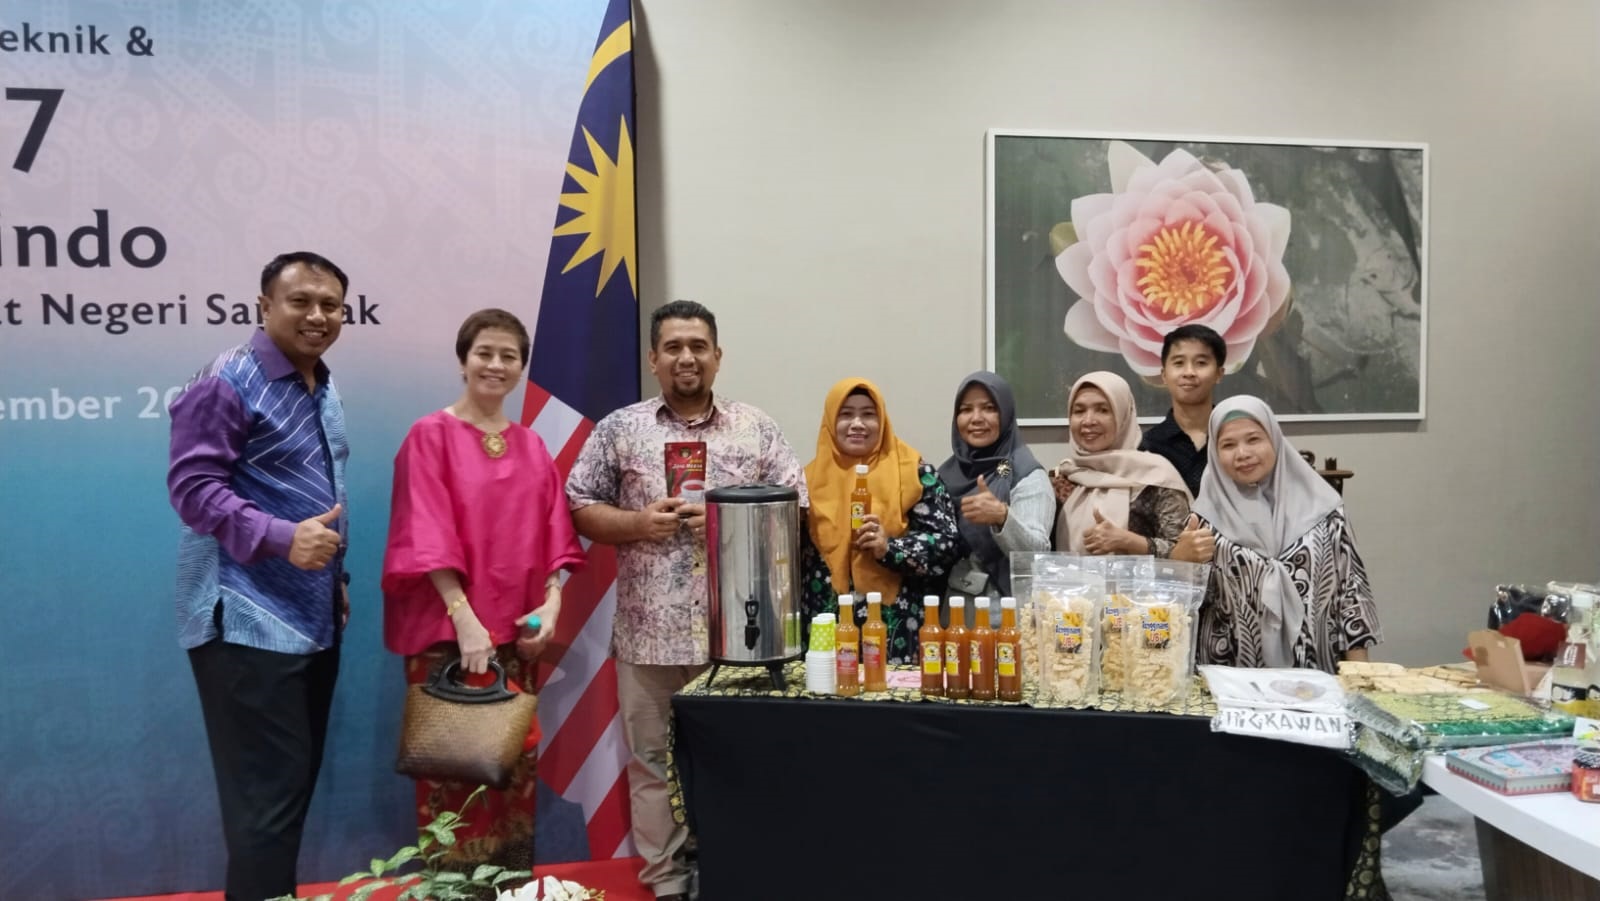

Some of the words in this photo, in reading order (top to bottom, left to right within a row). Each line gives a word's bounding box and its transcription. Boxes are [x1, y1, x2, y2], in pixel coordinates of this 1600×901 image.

[0, 22, 111, 55] eknik
[126, 26, 155, 57] &
[5, 87, 65, 173] 7
[0, 209, 167, 268] ndo
[0, 298, 22, 326] t
[41, 293, 187, 336] Negeri
[0, 387, 122, 420] mber
